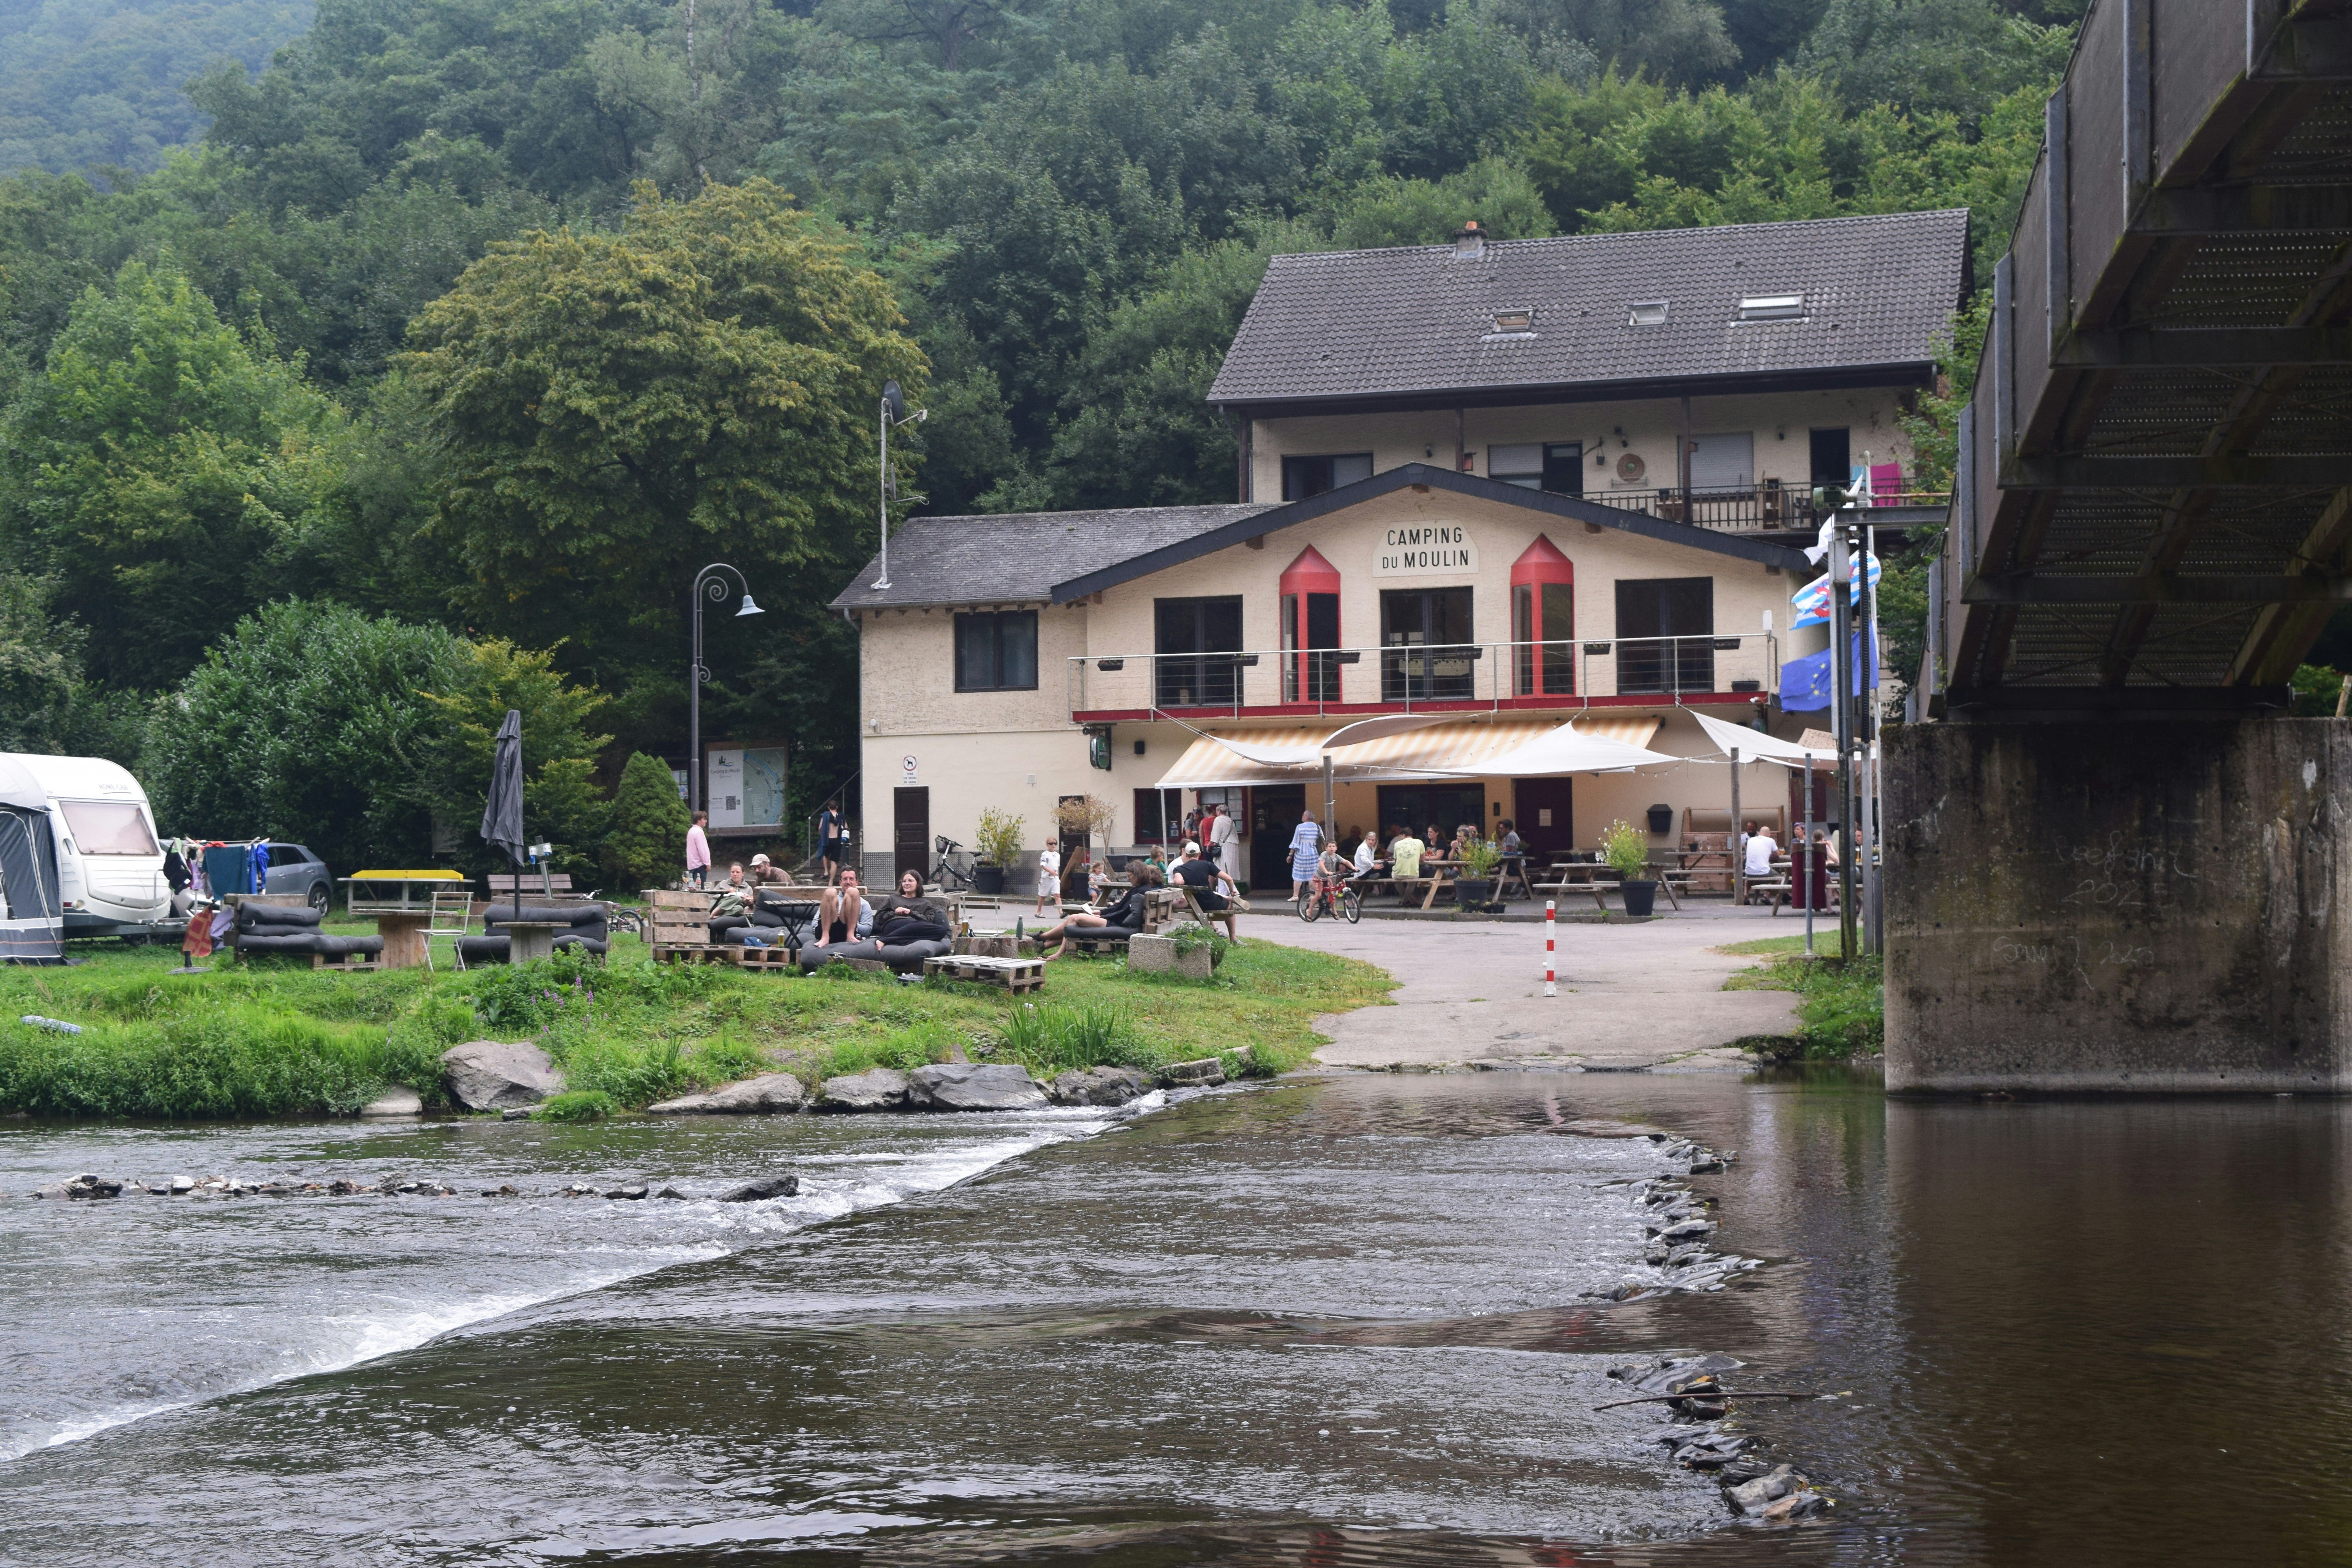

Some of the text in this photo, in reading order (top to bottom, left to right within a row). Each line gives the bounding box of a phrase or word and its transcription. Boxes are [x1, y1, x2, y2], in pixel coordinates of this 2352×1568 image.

[1388, 527, 1462, 546] CAMPING
[1382, 550, 1468, 569] DU MOULIN
